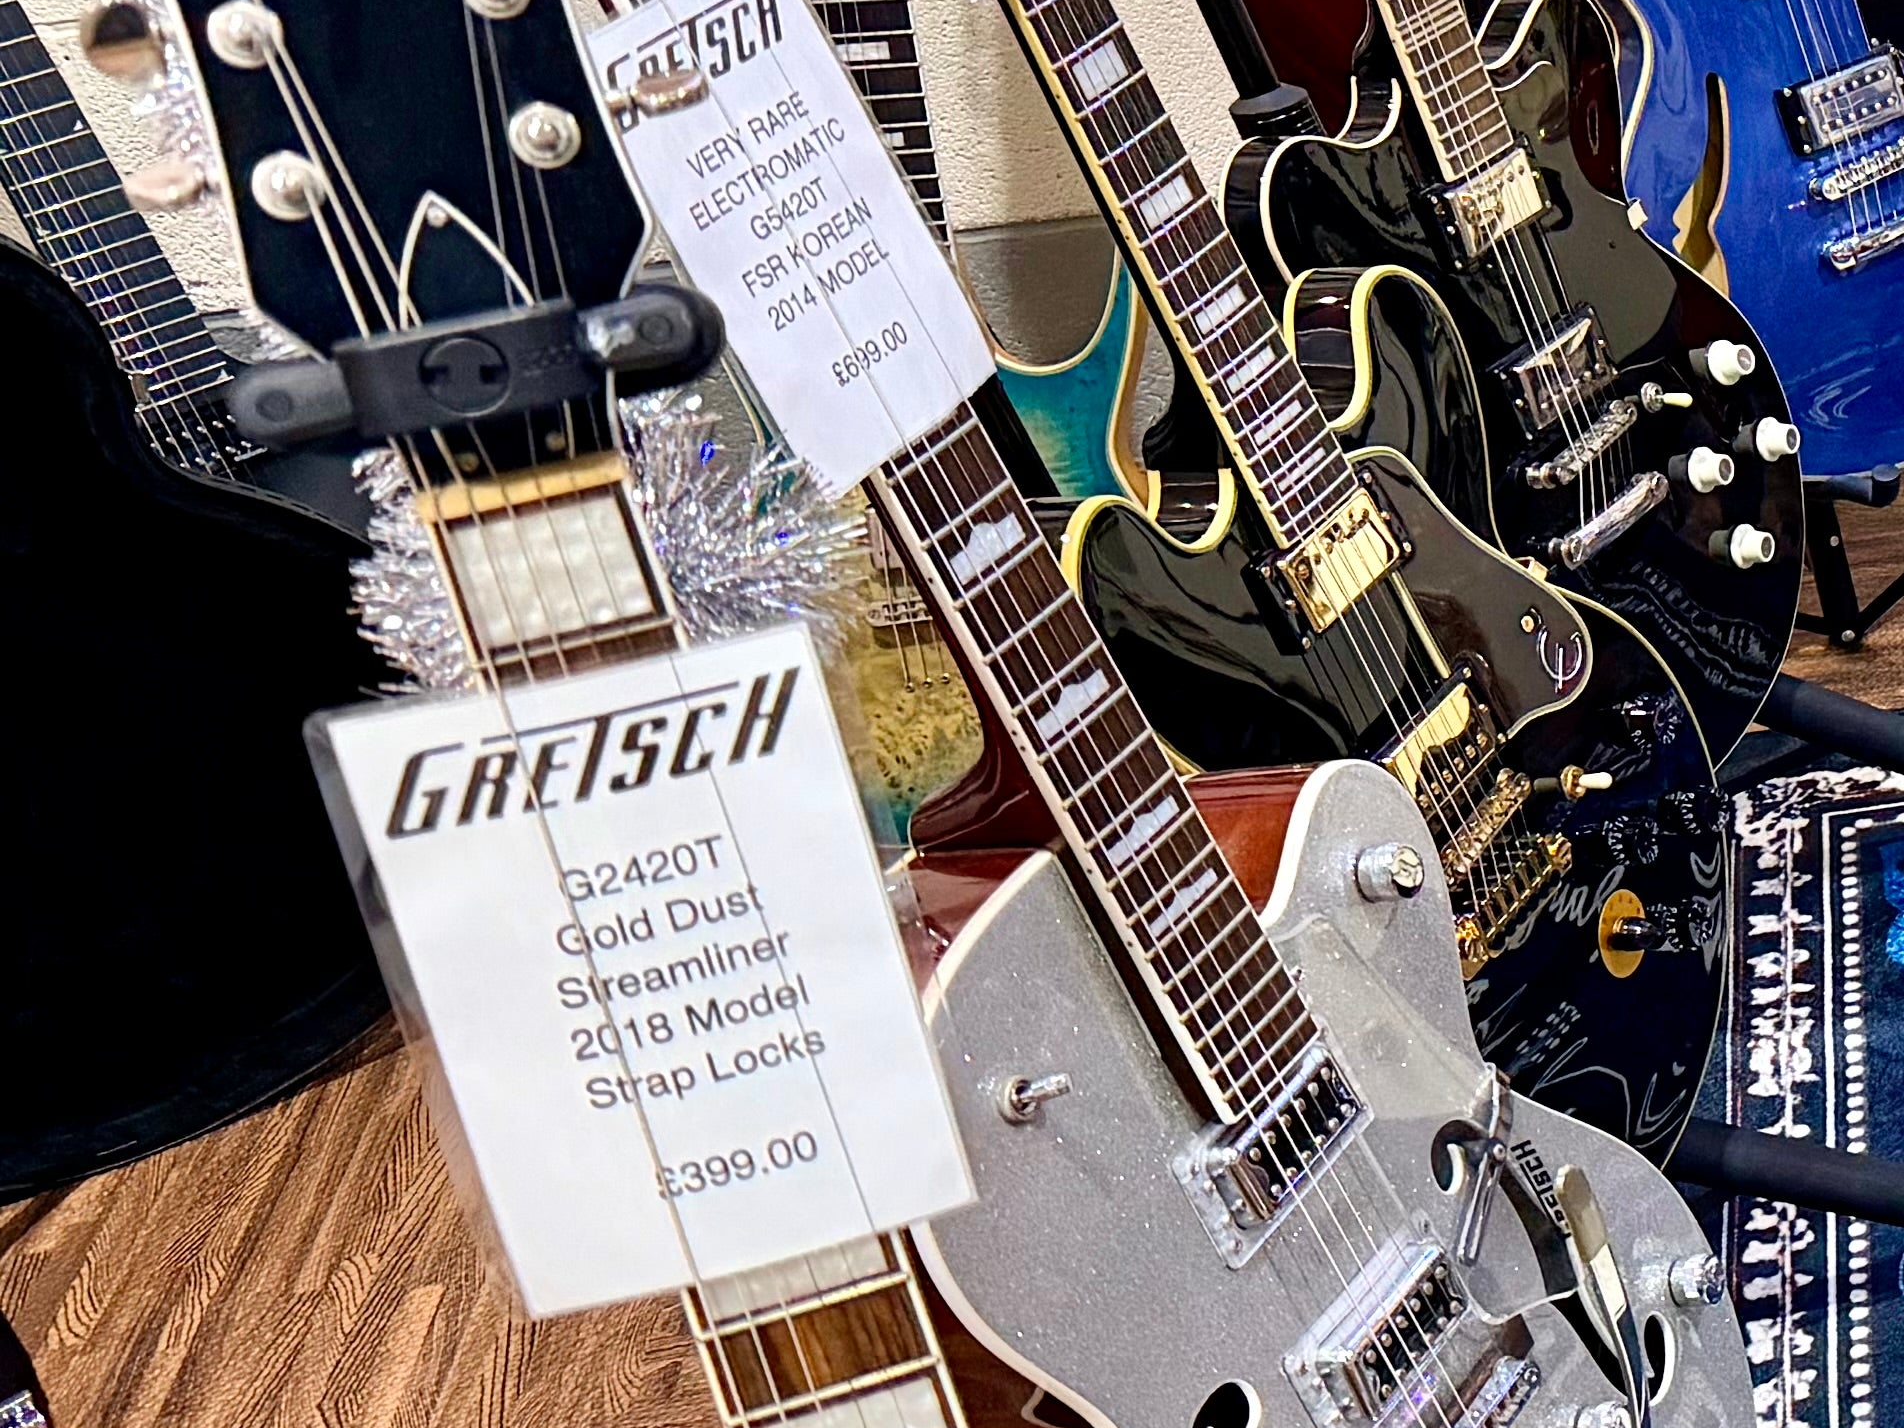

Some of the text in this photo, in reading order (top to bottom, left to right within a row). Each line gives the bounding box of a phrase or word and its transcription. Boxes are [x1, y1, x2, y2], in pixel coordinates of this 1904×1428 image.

[686, 90, 811, 179] VERY RARE
[688, 116, 847, 232] ELECTROMATIC
[741, 198, 874, 300] FSR KOREAN
[750, 177, 830, 242] G5420T
[767, 240, 891, 332] 2014 MODEL
[385, 666, 801, 840] GRETSCH
[560, 835, 725, 904] G2420T
[556, 880, 765, 958] Gold Dust
[556, 929, 791, 1010] Streamliner
[570, 974, 811, 1062] 2018 Model
[585, 1027, 827, 1112] Strap Locks
[656, 1130, 819, 1201] £399.00
